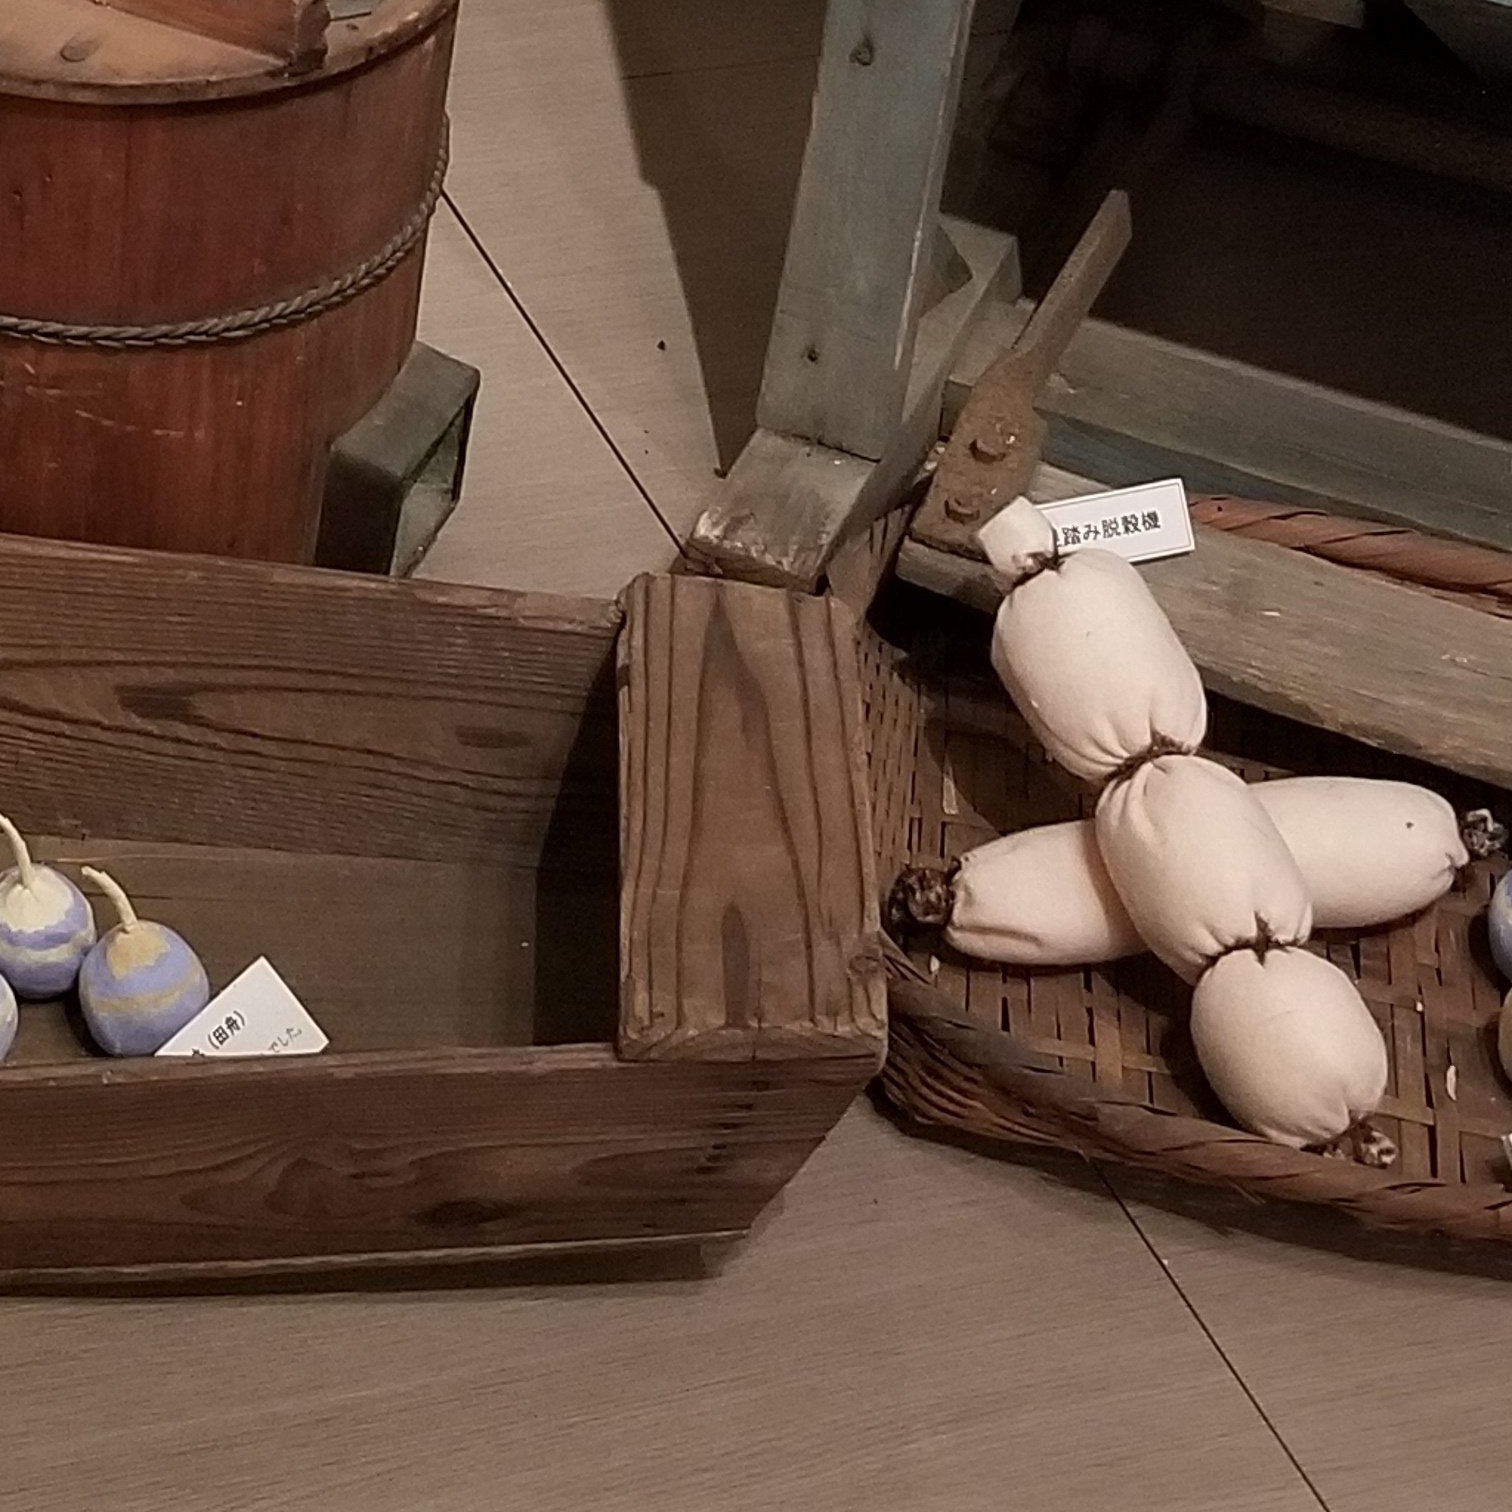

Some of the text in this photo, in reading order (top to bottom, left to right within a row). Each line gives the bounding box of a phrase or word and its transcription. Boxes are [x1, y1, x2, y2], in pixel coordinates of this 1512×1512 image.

[1055, 509, 1162, 548] 踏み脱穀機
